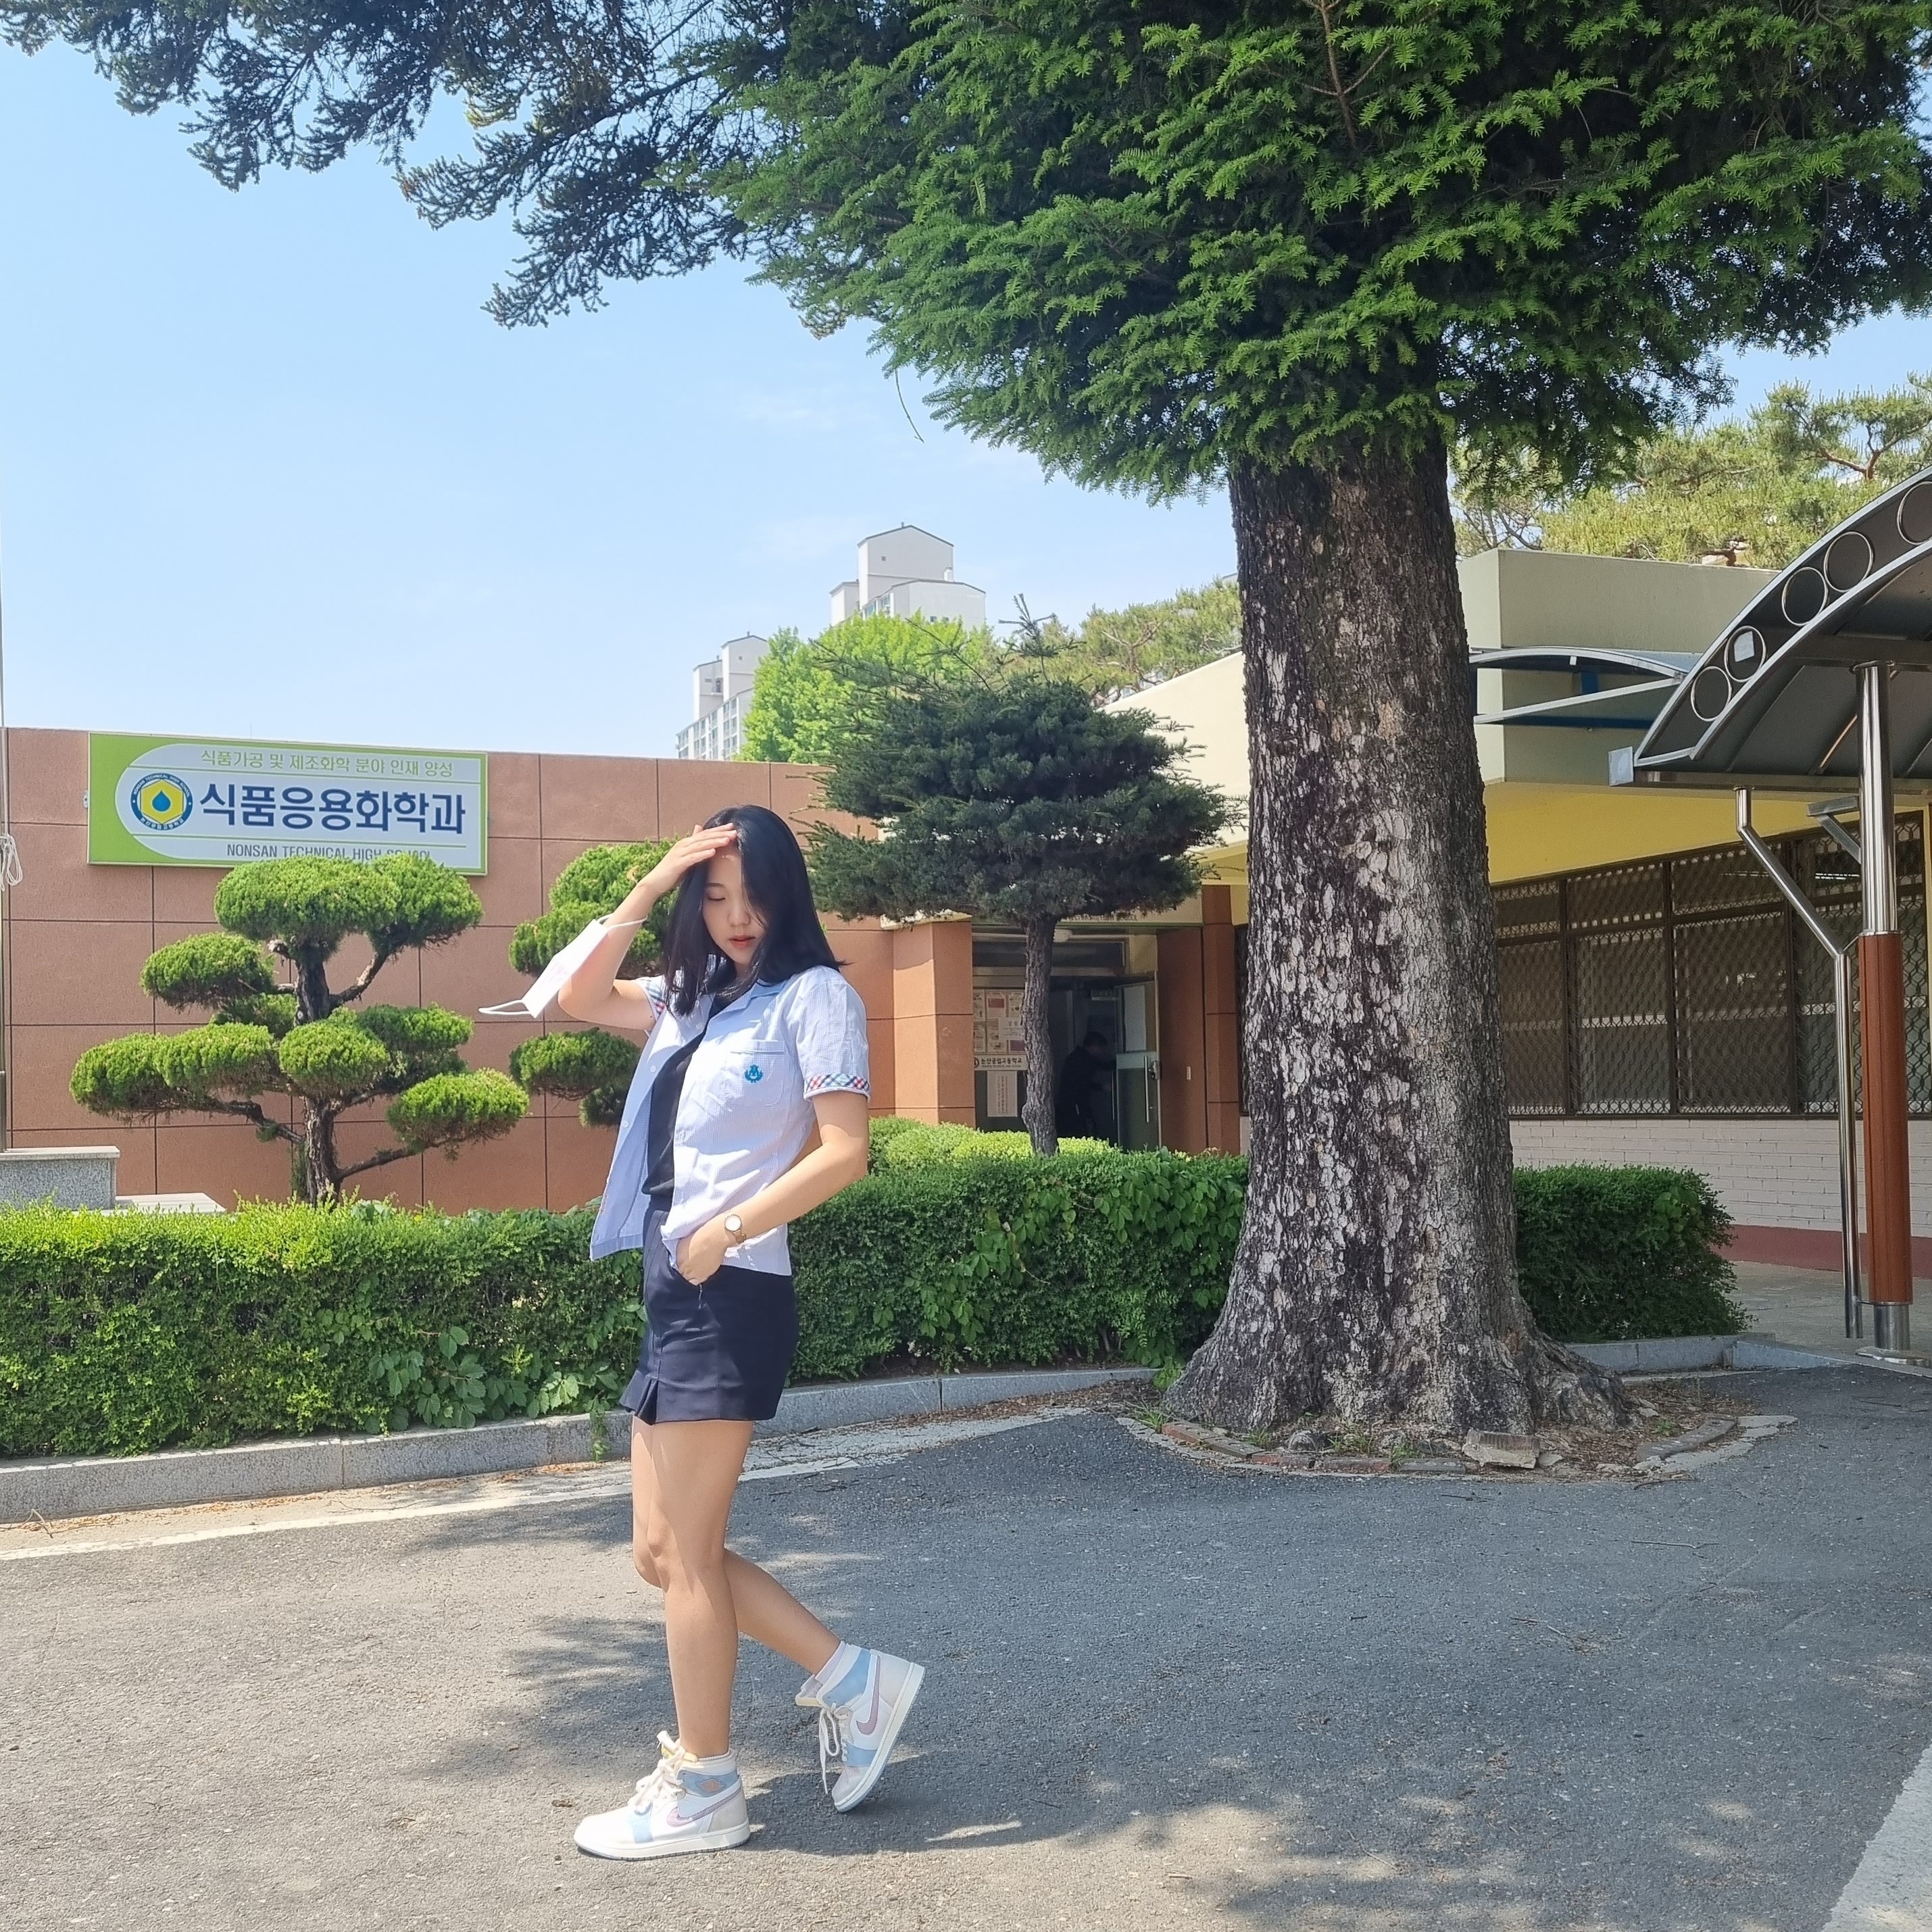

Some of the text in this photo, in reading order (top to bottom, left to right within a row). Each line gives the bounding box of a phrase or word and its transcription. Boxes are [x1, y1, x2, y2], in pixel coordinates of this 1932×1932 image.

[201, 750, 453, 777] 식품가공 및 제조화학 분야 인재 양성
[200, 783, 466, 834] 식품응용화학과
[227, 843, 277, 858] NONSAN
[282, 845, 345, 860] TECHNICAL
[353, 848, 381, 861] HIGH
